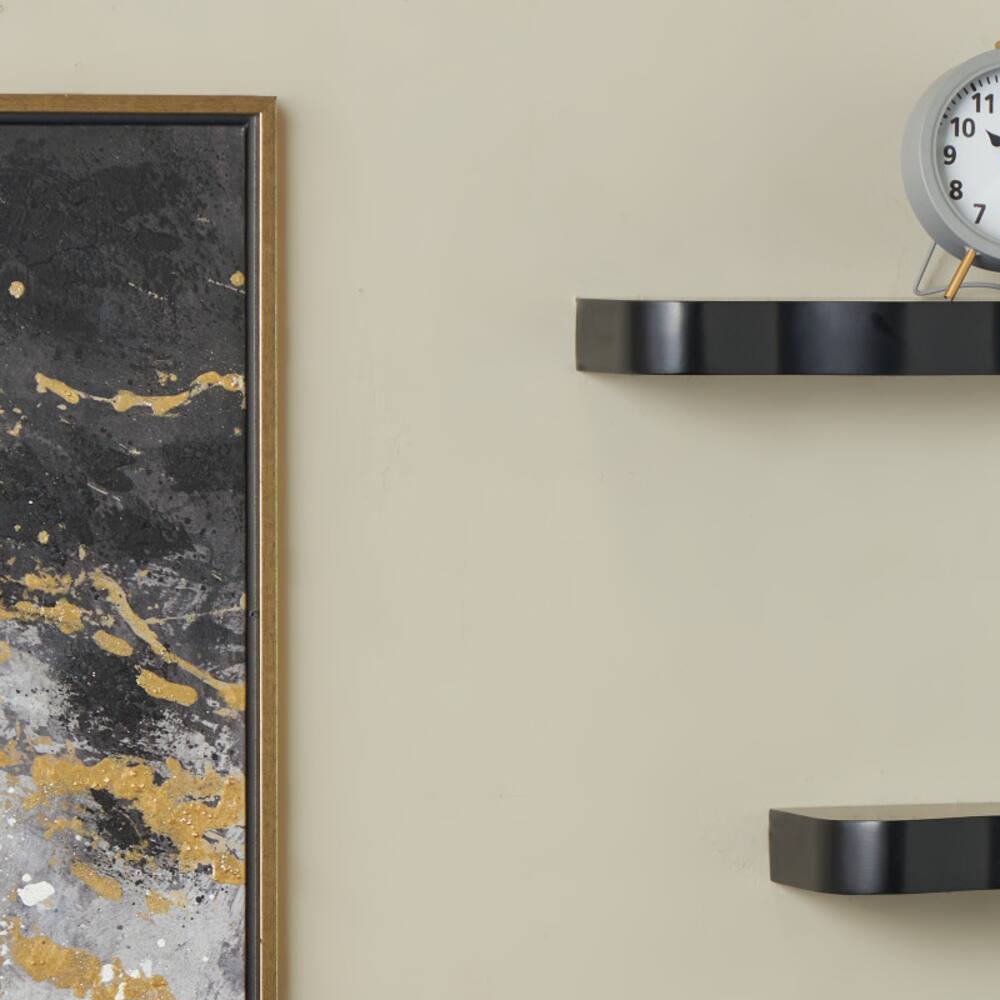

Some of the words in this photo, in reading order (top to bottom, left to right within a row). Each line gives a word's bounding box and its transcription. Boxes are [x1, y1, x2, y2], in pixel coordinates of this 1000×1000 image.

[971, 93, 994, 115] 11
[950, 117, 976, 138] 10
[943, 145, 957, 166] 9
[949, 180, 963, 201] 8
[973, 203, 987, 225] 7
